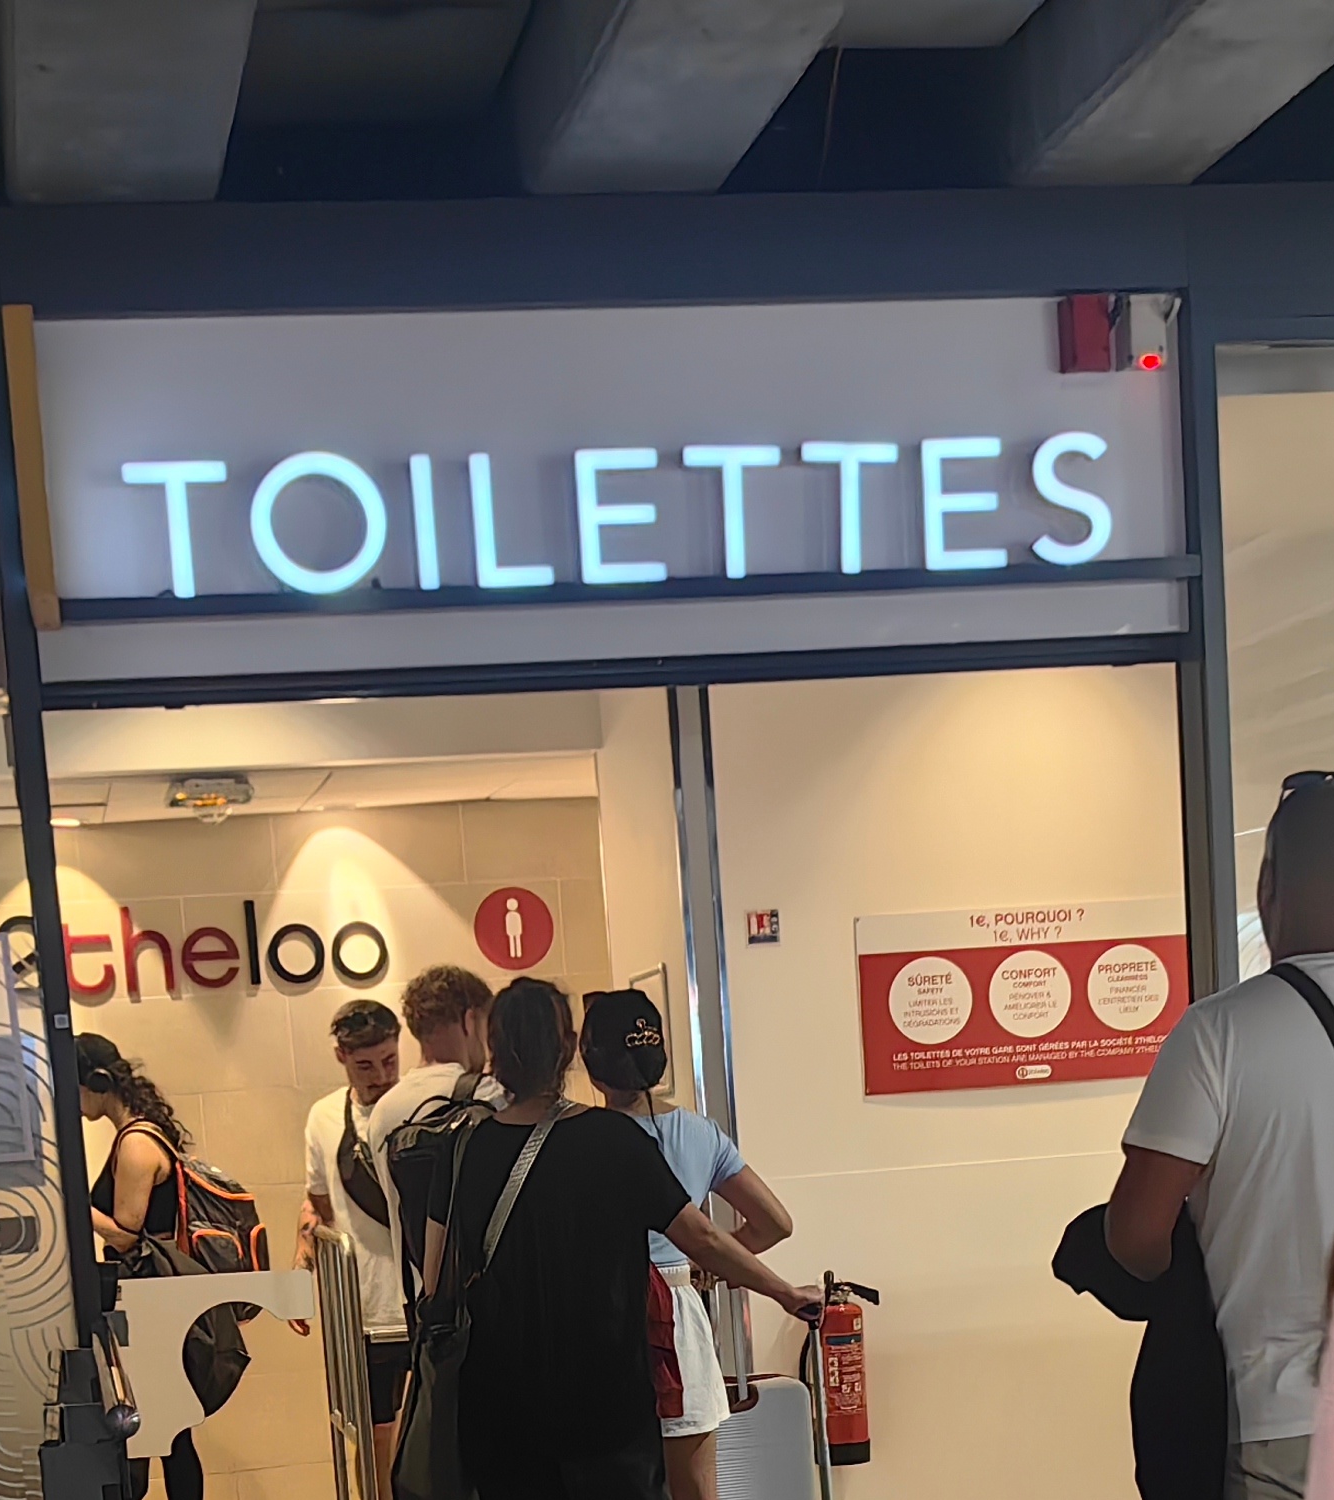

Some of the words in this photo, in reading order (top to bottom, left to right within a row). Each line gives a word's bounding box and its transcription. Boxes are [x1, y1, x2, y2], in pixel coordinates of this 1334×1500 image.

[120, 430, 1113, 598] TOILETTES
[994, 911, 1072, 926] POURQUOI
[1076, 909, 1085, 921] ?
[1016, 927, 1050, 942] WHY
[1054, 927, 1062, 939] ?
[1001, 968, 1057, 981] CONFORT
[1097, 961, 1158, 975] PROPRETÉ
[907, 972, 953, 987] SÛRETÉ
[893, 1052, 909, 1062] LES
[910, 1049, 950, 1060] TOILETTES
[952, 1048, 964, 1057] DE
[965, 1046, 991, 1056] VOTRE
[992, 1044, 1014, 1054] GARE
[1016, 1043, 1037, 1052] SONT
[1038, 1040, 1070, 1051] GÉRÉES
[1071, 1038, 1087, 1048] PAR
[1088, 1039, 1099, 1048] LA
[893, 1062, 909, 1071] THE
[909, 1059, 941, 1069] TOILETS
[978, 1053, 1010, 1064] STATION
[1080, 1048, 1096, 1058] THE
